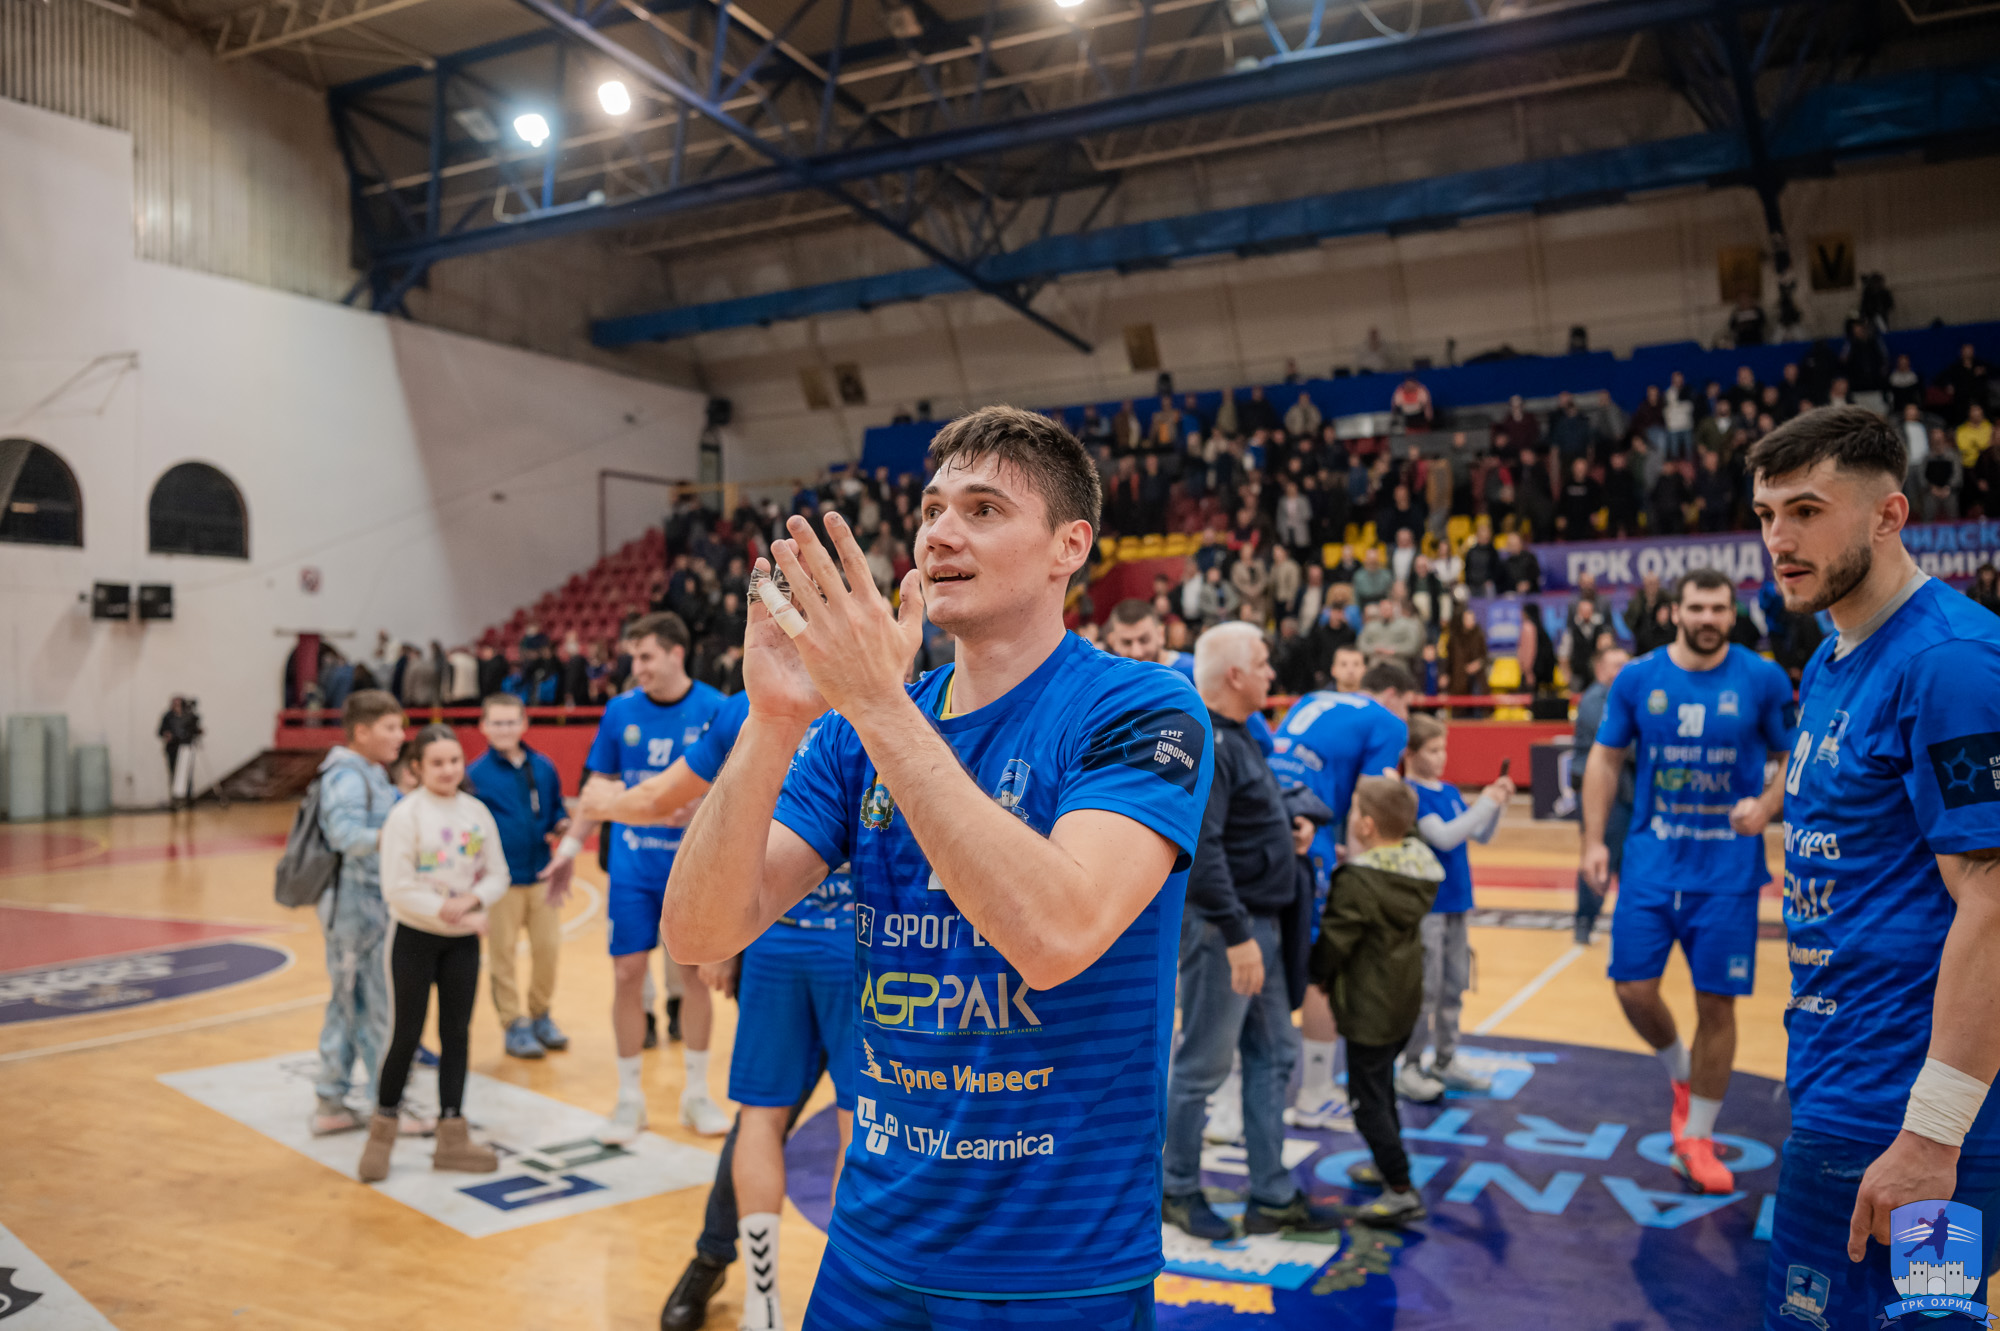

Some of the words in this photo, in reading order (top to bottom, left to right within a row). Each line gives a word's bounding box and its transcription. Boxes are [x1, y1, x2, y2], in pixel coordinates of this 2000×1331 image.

[1566, 549, 1633, 585] ГРК
[1636, 541, 1765, 583] ОХРИД
[1160, 729, 1184, 740] EHF
[1153, 750, 1171, 765] CUP
[1156, 740, 1195, 770] EUROPEAN
[861, 968, 1042, 1030] ASPPAK
[889, 1060, 948, 1094] Трпе
[952, 1065, 1055, 1094] Инвест
